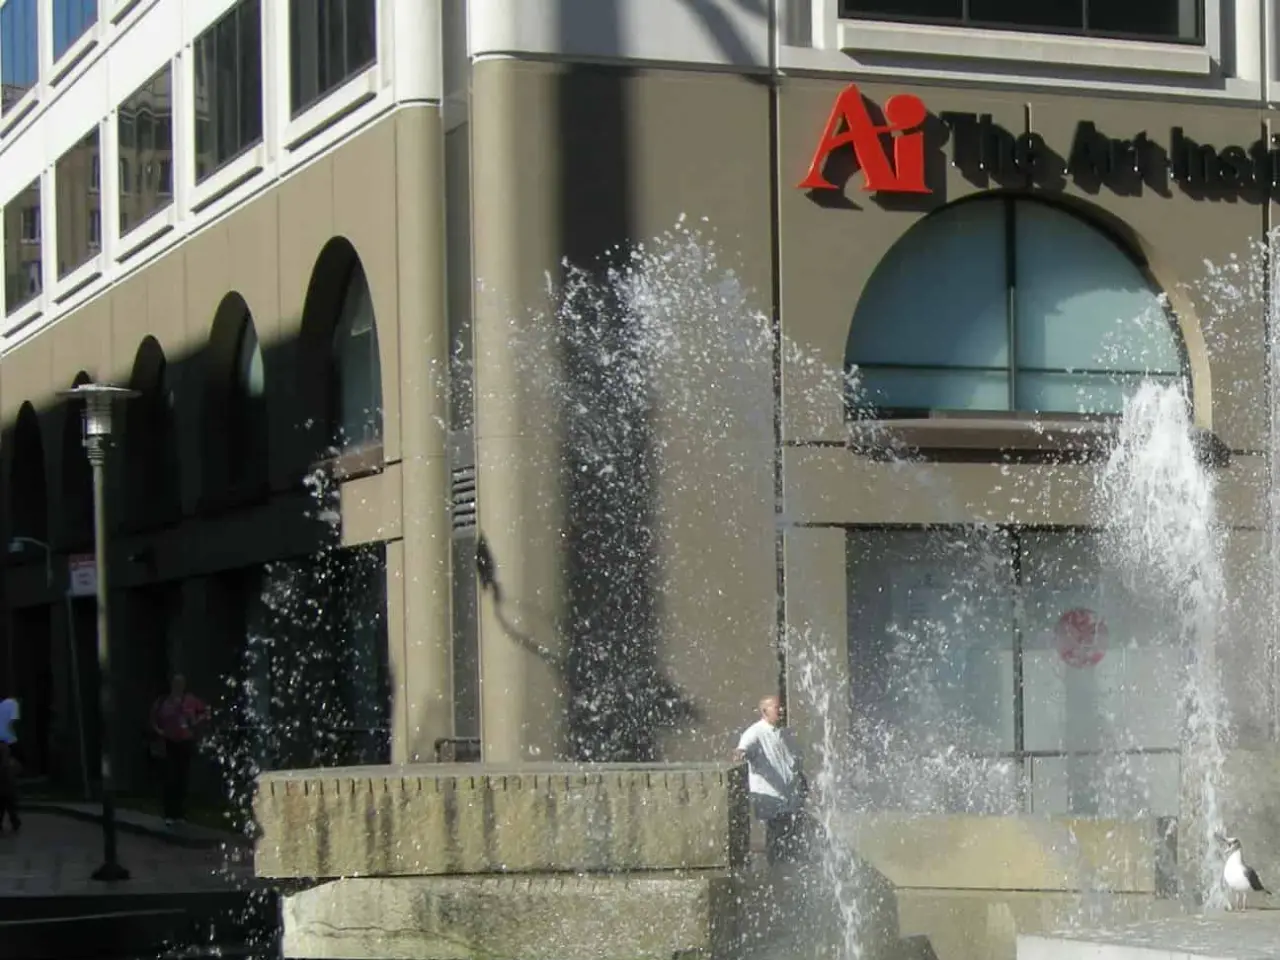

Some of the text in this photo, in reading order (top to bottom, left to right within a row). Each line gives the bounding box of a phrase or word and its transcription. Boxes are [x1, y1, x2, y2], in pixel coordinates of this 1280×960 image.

[797, 83, 932, 193] Ai
[941, 112, 1043, 172] The
[1062, 120, 1147, 174] Art
